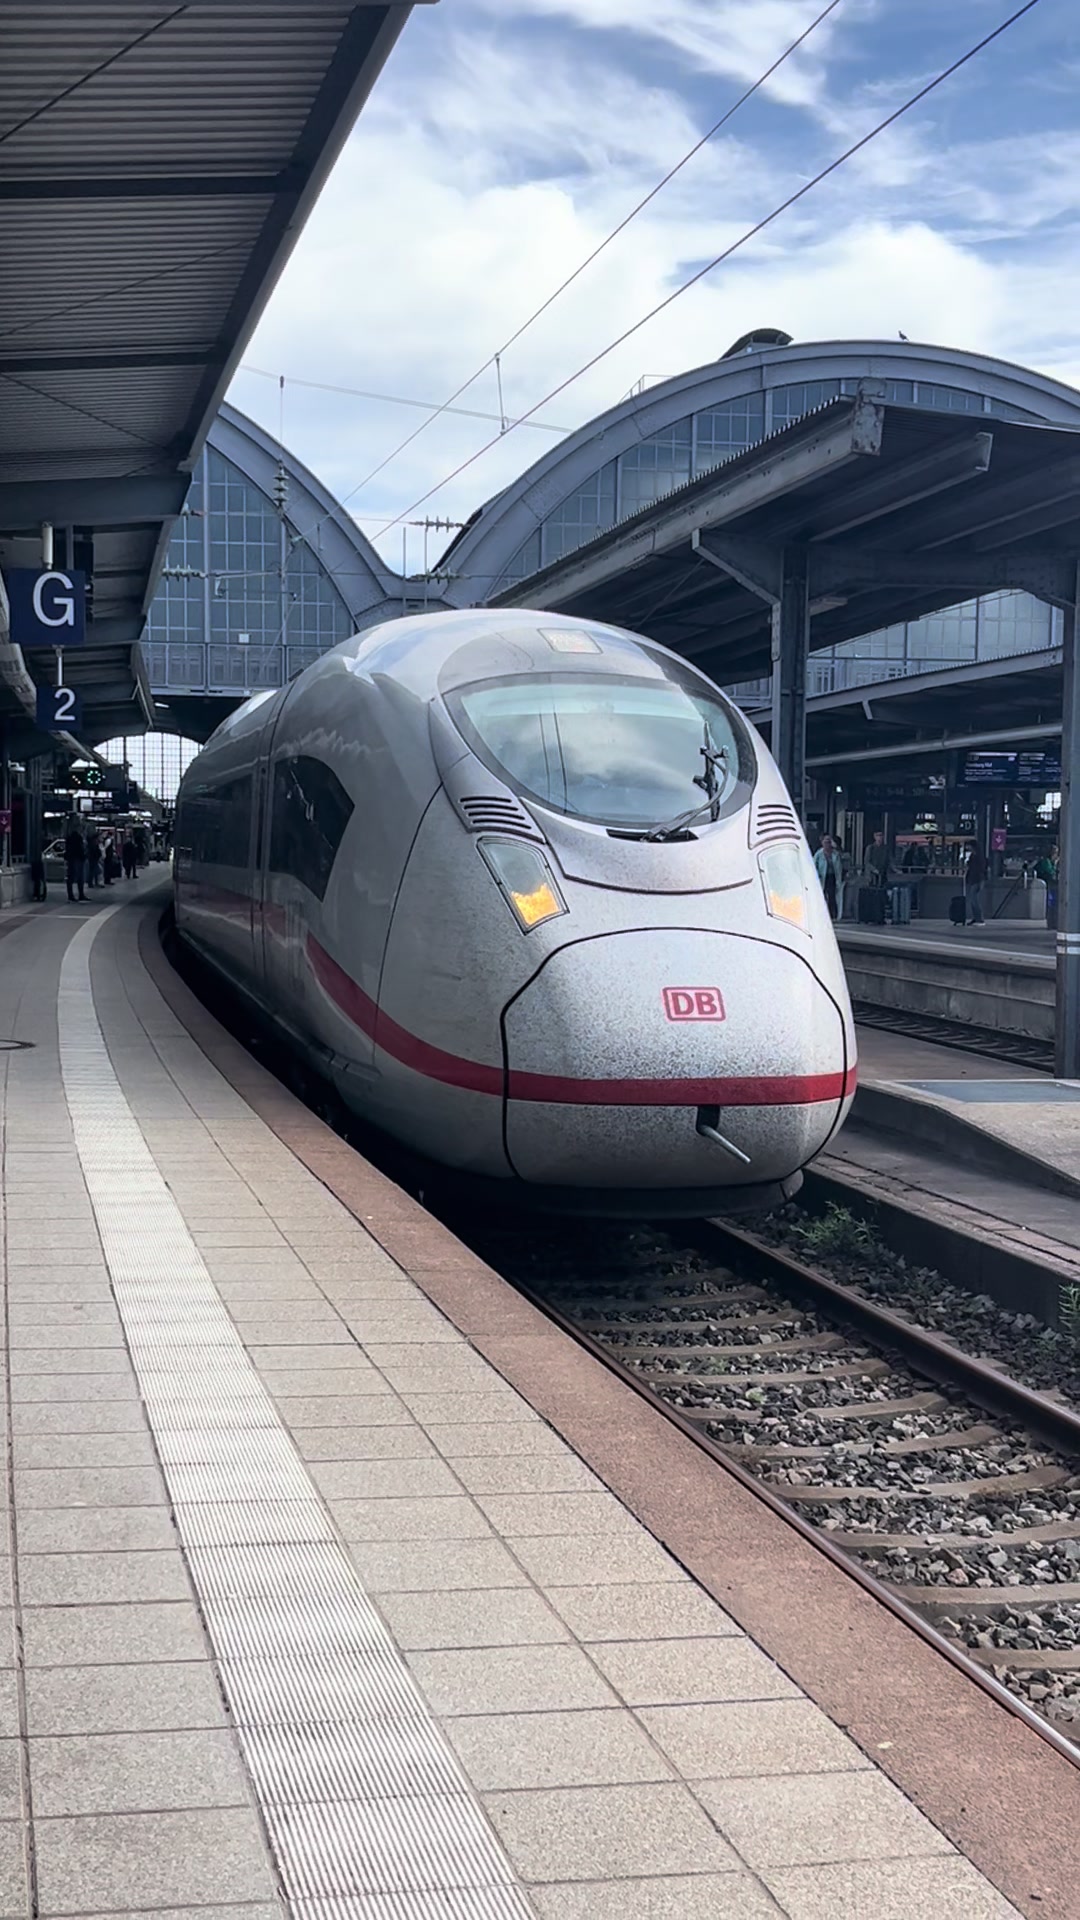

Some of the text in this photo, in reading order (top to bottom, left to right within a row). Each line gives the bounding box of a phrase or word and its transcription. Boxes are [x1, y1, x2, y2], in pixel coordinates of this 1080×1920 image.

[33, 571, 75, 626] G
[54, 688, 76, 721] 2
[669, 991, 719, 1016] DB
